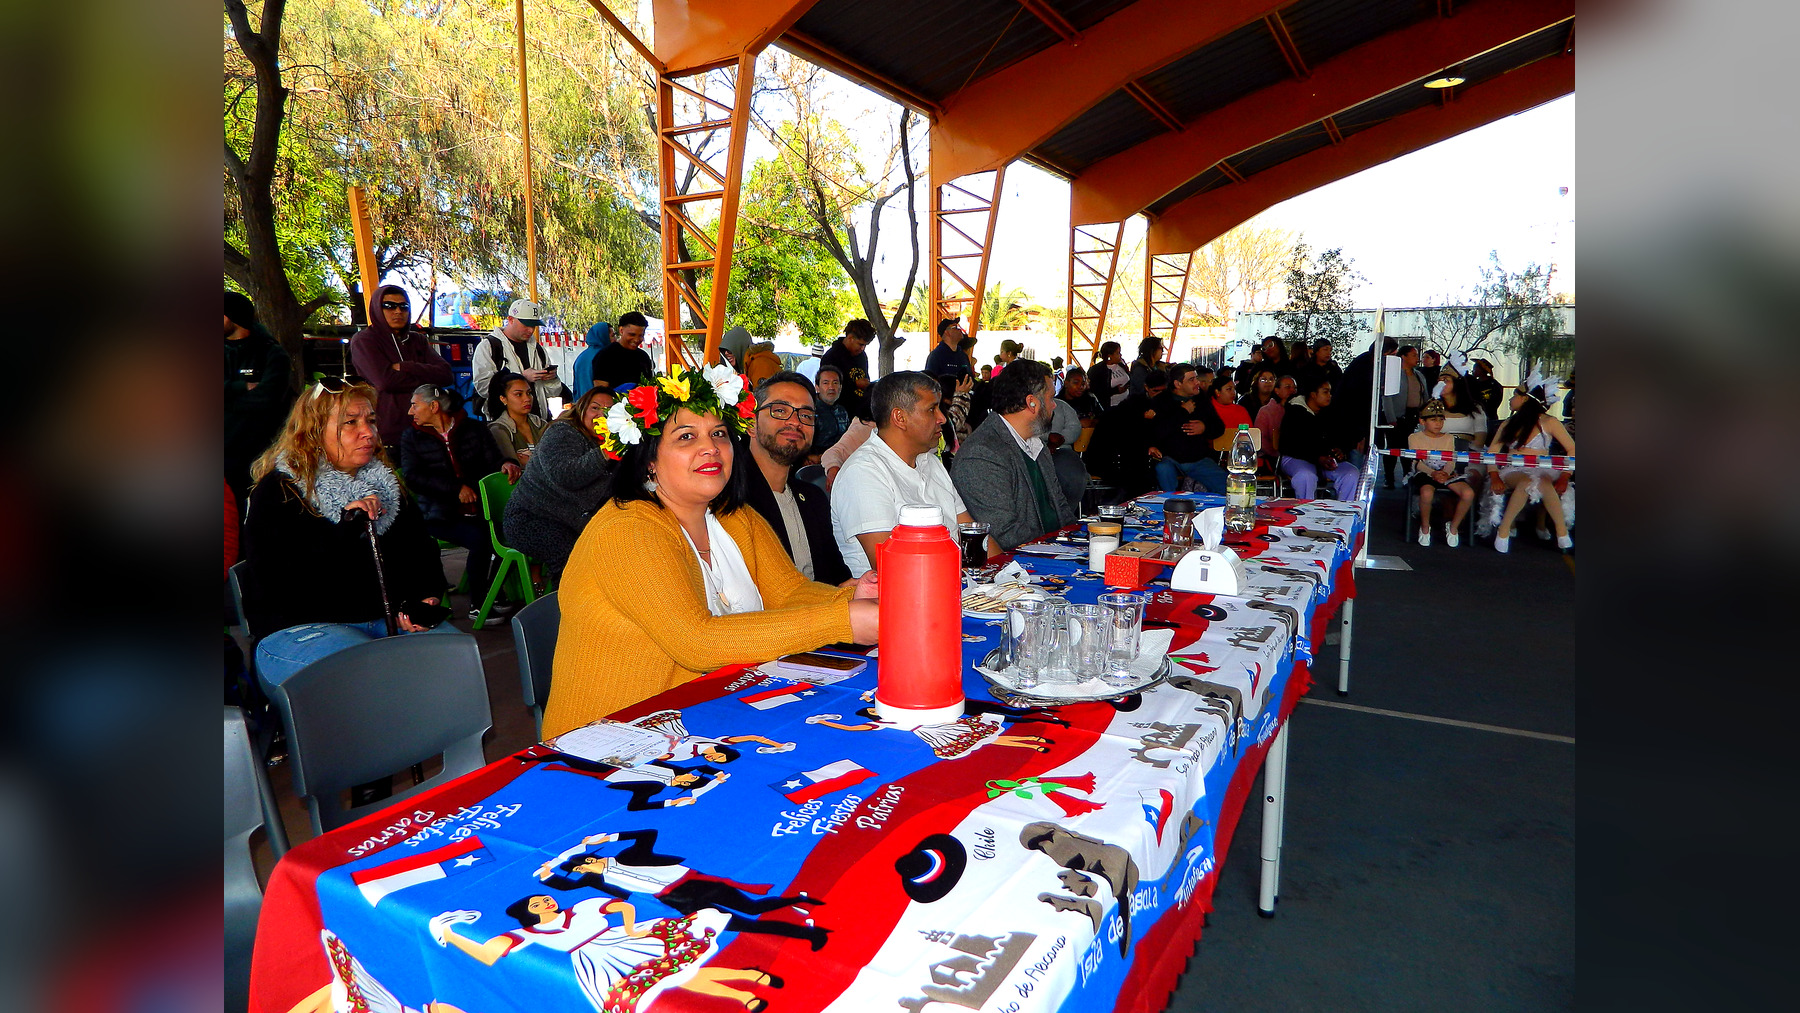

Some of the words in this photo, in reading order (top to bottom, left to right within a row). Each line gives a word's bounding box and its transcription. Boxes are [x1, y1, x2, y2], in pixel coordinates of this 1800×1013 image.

[532, 307, 539, 317] B
[404, 805, 483, 847] Fiestas
[449, 803, 522, 843] Felices
[772, 798, 823, 837] Felices
[812, 793, 862, 835] Fiestas
[855, 785, 905, 830] Patrias
[347, 810, 435, 857] Patrias
[973, 826, 995, 861] Chile
[1079, 937, 1103, 989] Isla
[1108, 914, 1124, 944] de
[1014, 981, 1034, 999] de
